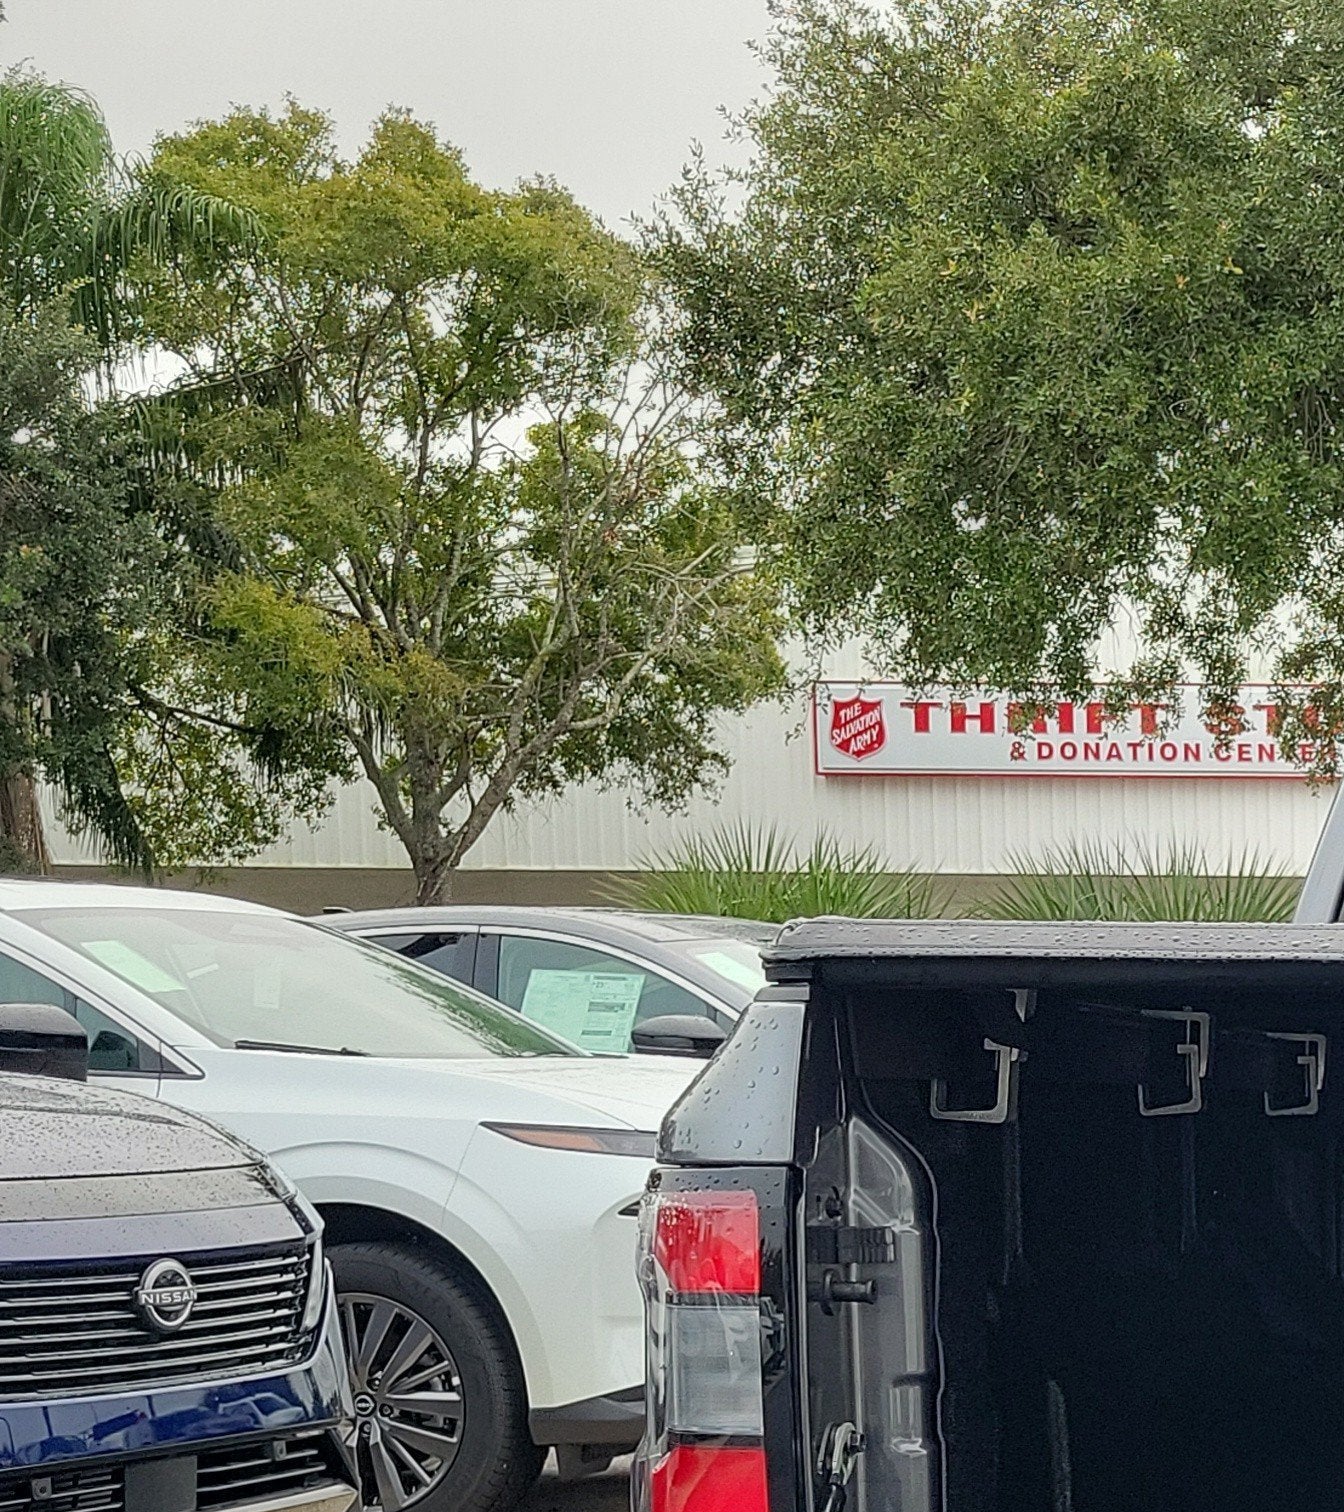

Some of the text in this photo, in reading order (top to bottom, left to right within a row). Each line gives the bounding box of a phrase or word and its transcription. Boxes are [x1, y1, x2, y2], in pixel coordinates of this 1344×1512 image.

[838, 702, 862, 724] THE
[831, 705, 881, 745] SALVATION
[849, 724, 880, 755] ARMY
[1037, 741, 1201, 762] DONATION
[1213, 742, 1337, 763] CENE
[141, 1290, 197, 1304] NISSAN
